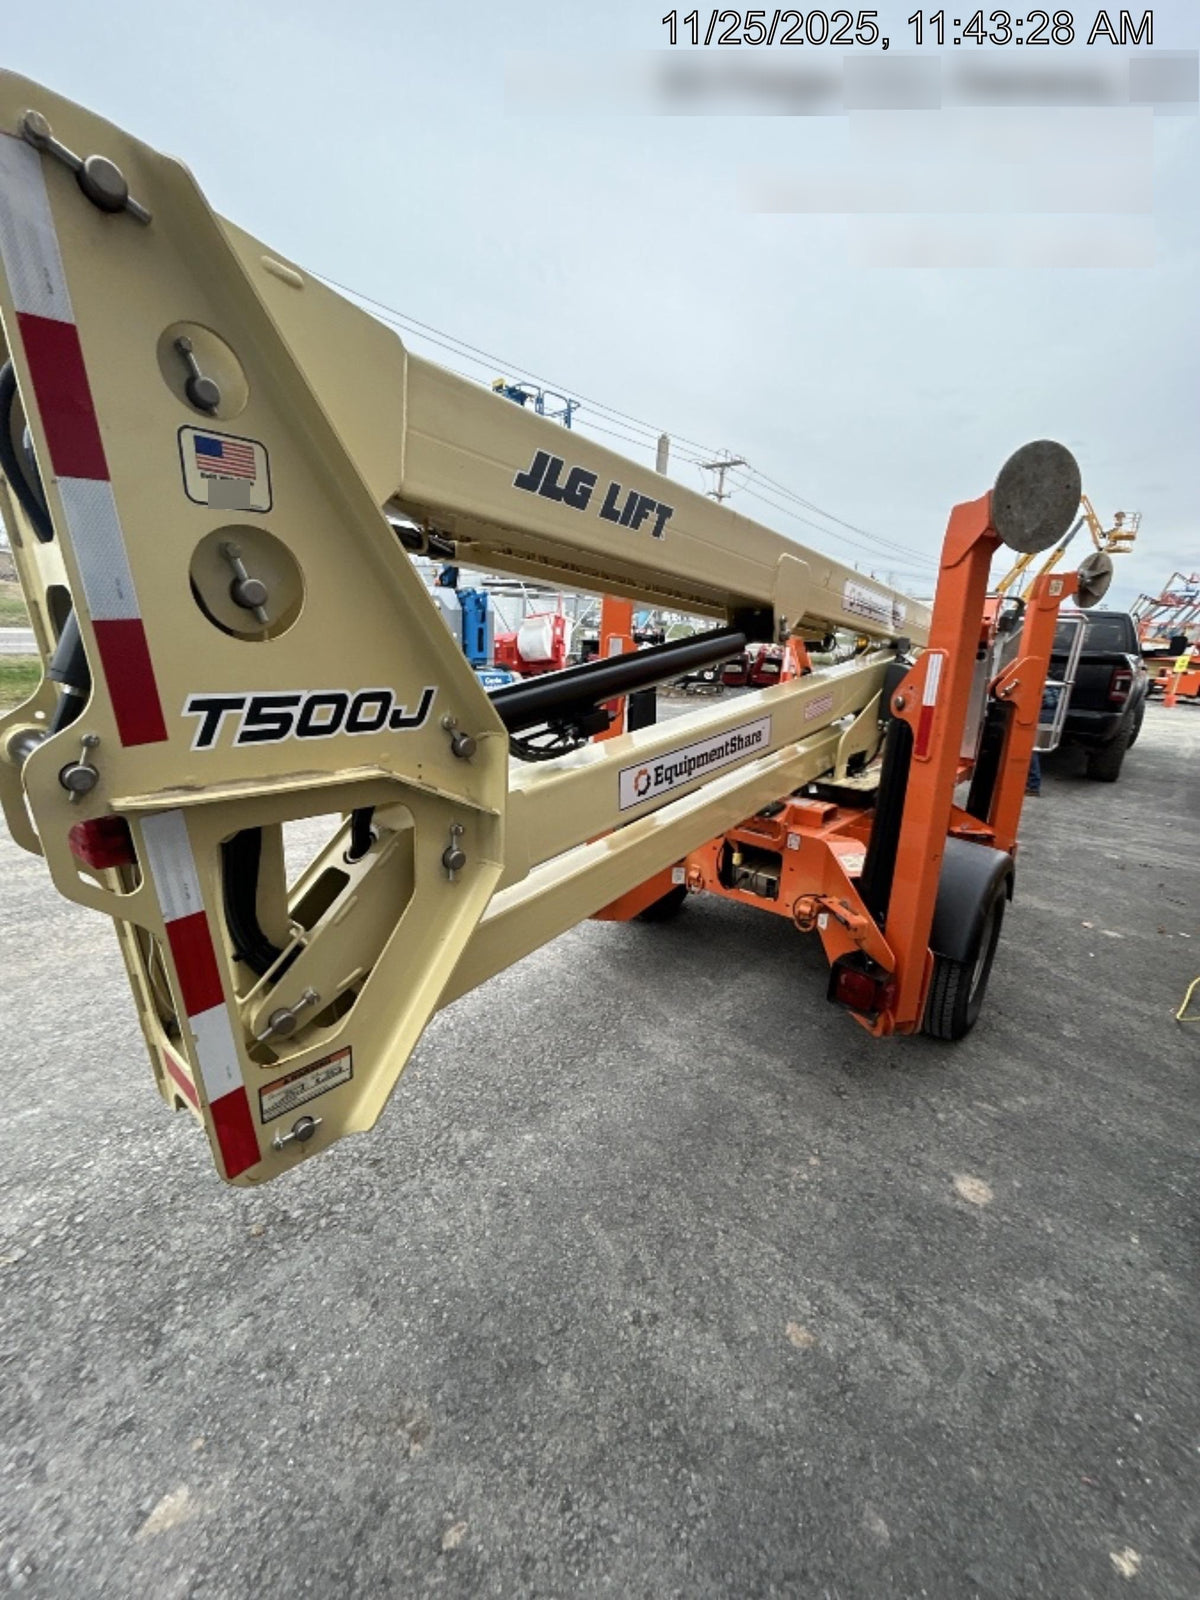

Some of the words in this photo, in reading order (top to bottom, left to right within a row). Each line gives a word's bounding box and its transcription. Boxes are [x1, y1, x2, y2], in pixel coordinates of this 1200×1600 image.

[512, 448, 599, 512] JLG
[598, 480, 675, 541] LIFT
[182, 686, 438, 751] T500J
[653, 729, 763, 786] EquipmentShare
